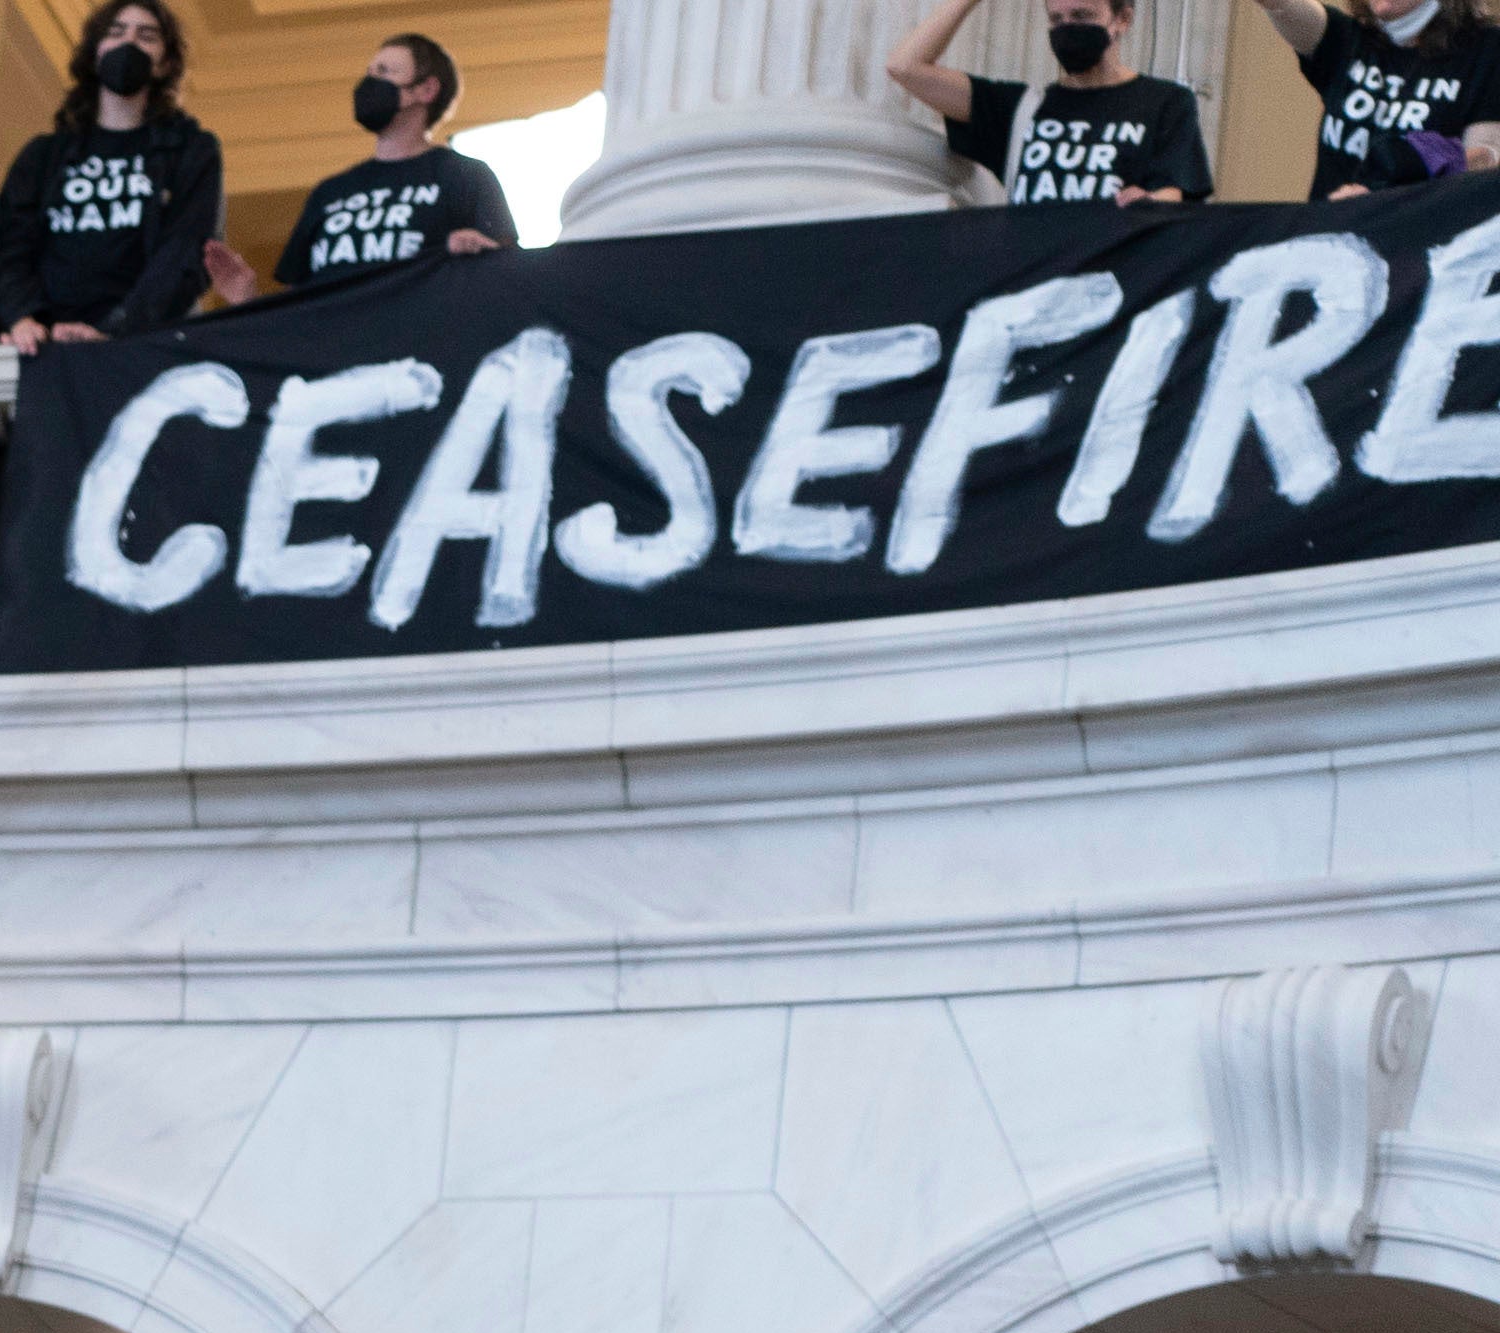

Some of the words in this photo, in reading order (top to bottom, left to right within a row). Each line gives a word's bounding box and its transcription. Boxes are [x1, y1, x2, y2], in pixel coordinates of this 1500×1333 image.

[1414, 76, 1462, 101] IN
[1342, 90, 1431, 132] OUR
[1102, 121, 1147, 146] IN
[1322, 119, 1371, 162] NA
[66, 155, 129, 180] OT
[1021, 141, 1118, 172] OUR
[62, 172, 154, 204] OUR
[400, 182, 440, 206] IN
[46, 198, 143, 233] NAM
[322, 203, 414, 235] OUR
